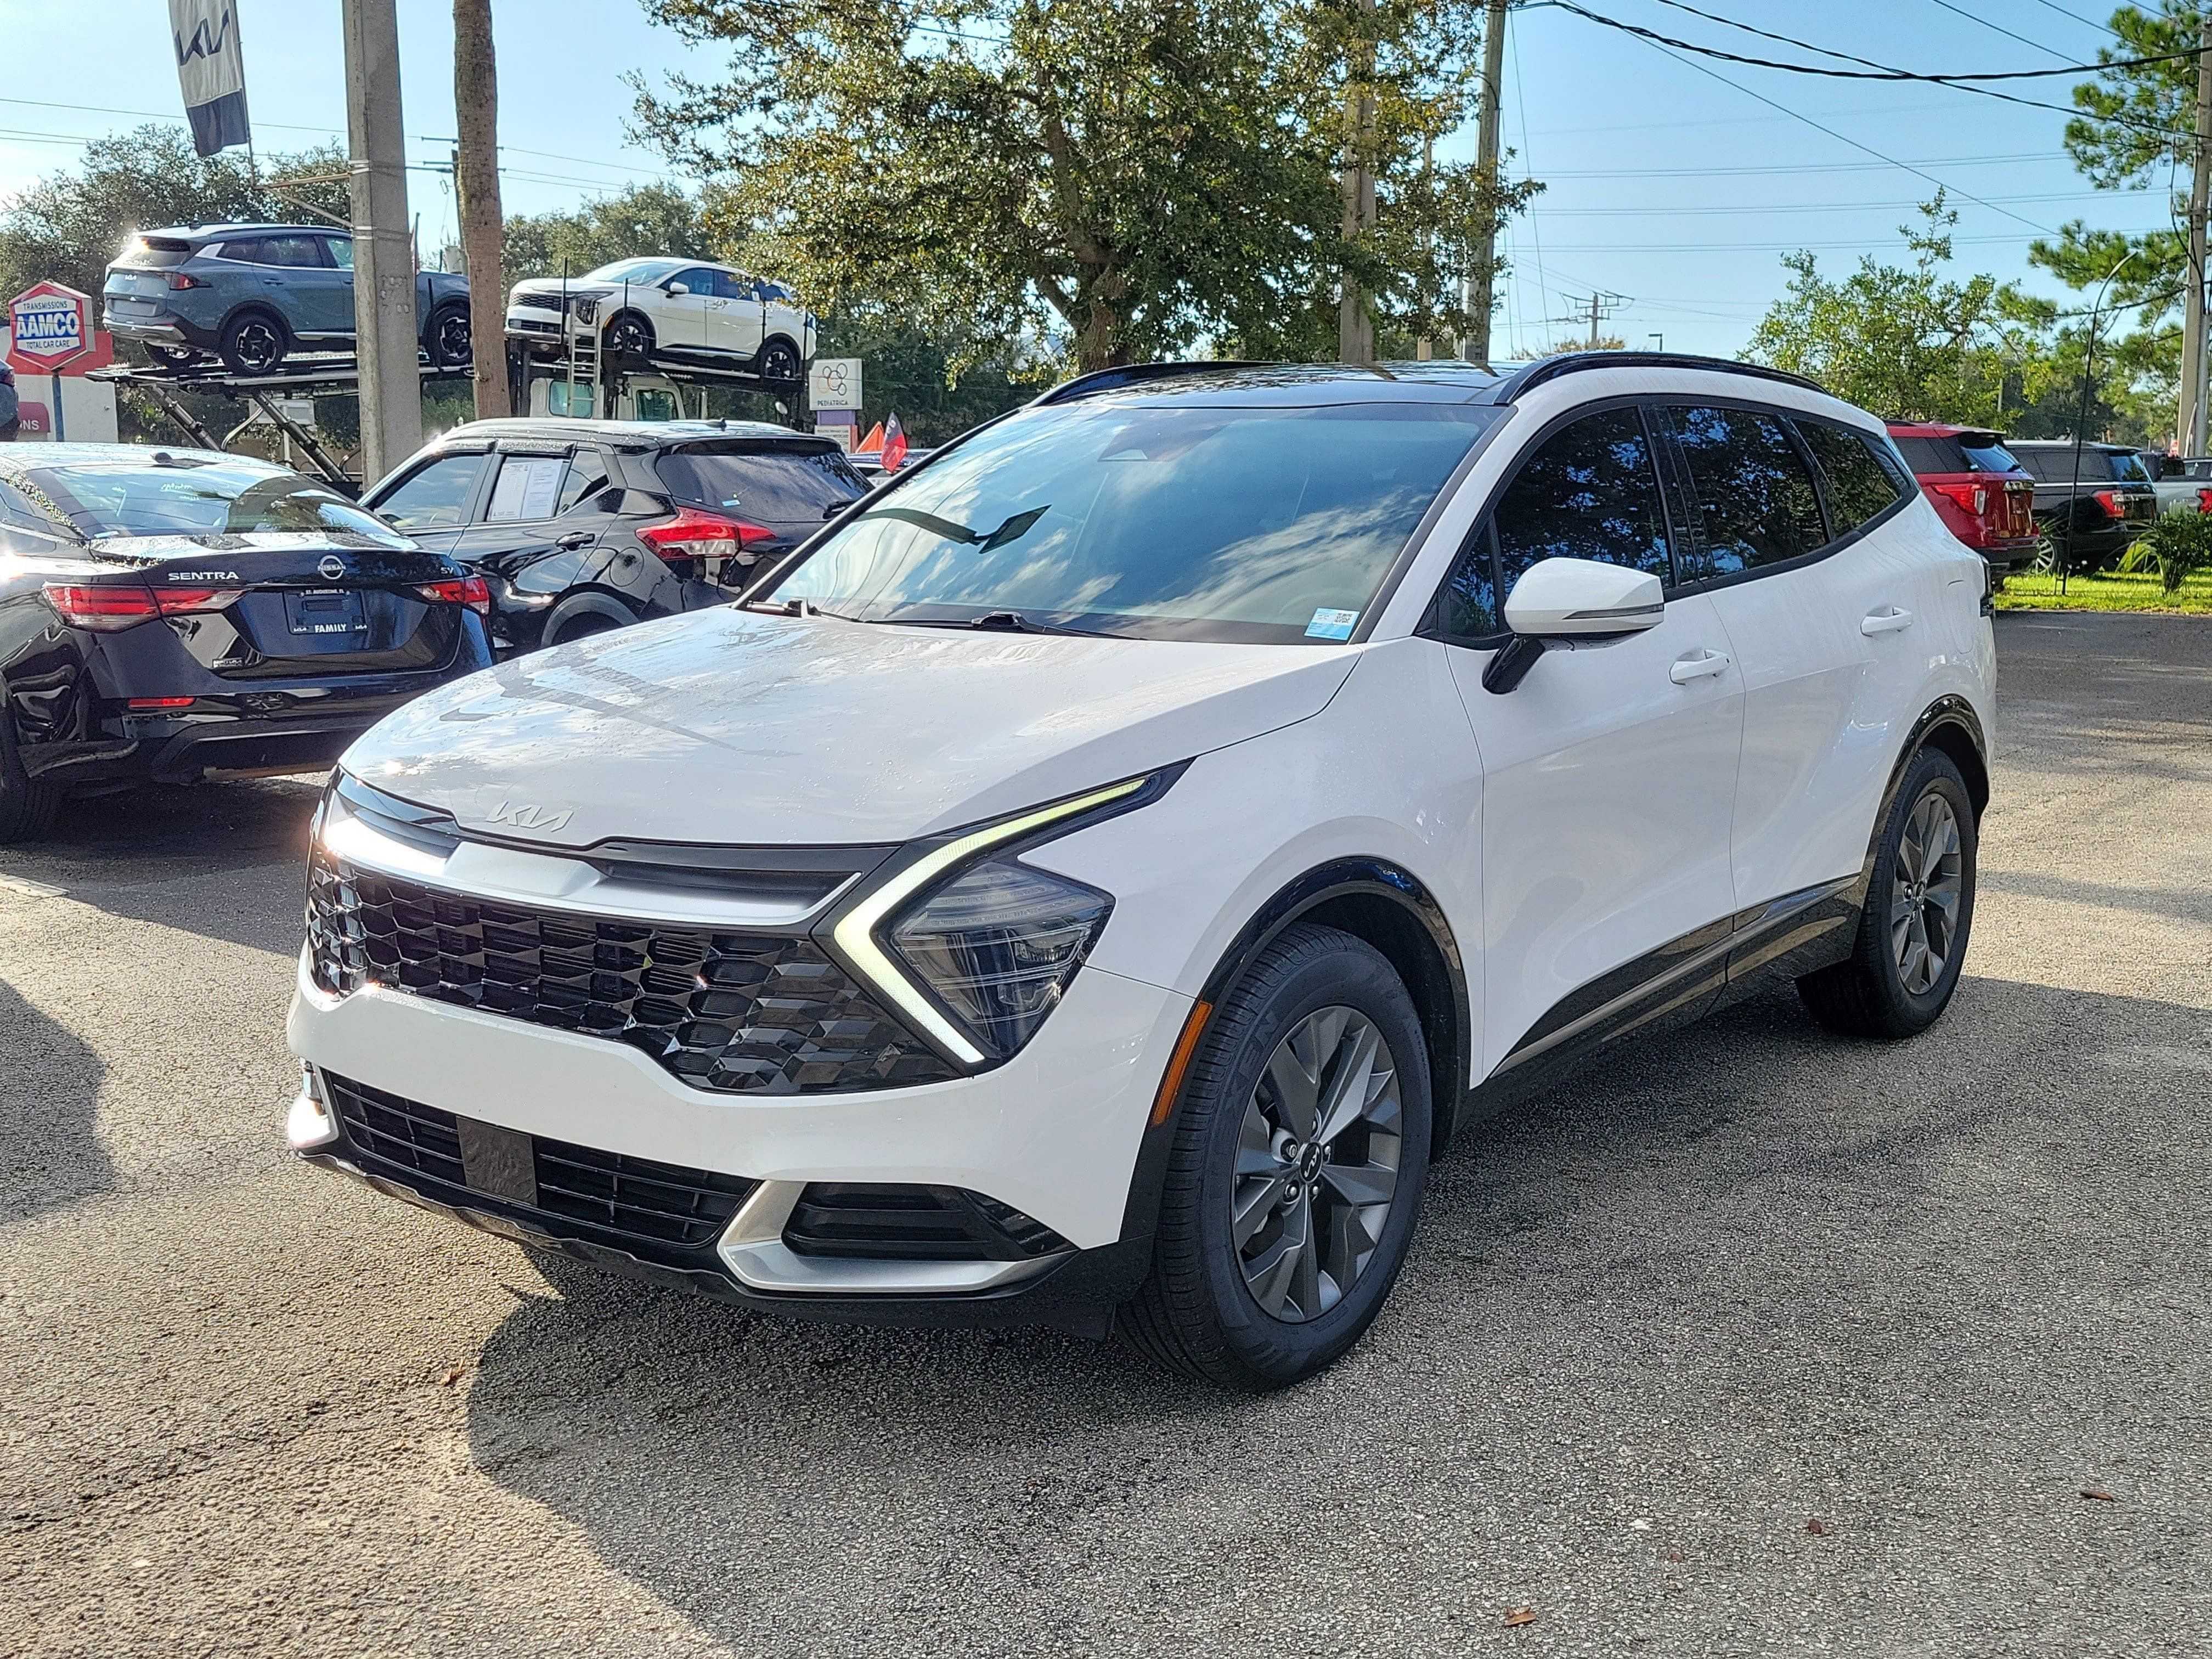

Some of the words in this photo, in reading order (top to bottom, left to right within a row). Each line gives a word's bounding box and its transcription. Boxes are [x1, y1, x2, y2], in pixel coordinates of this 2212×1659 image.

[23, 301, 67, 311] TRANSMISSIONS
[16, 312, 80, 338] AAMCO
[43, 340, 54, 348] CAR
[168, 571, 240, 581] SENTRA
[314, 623, 347, 633] FAMILY
[486, 800, 575, 833] KIA
